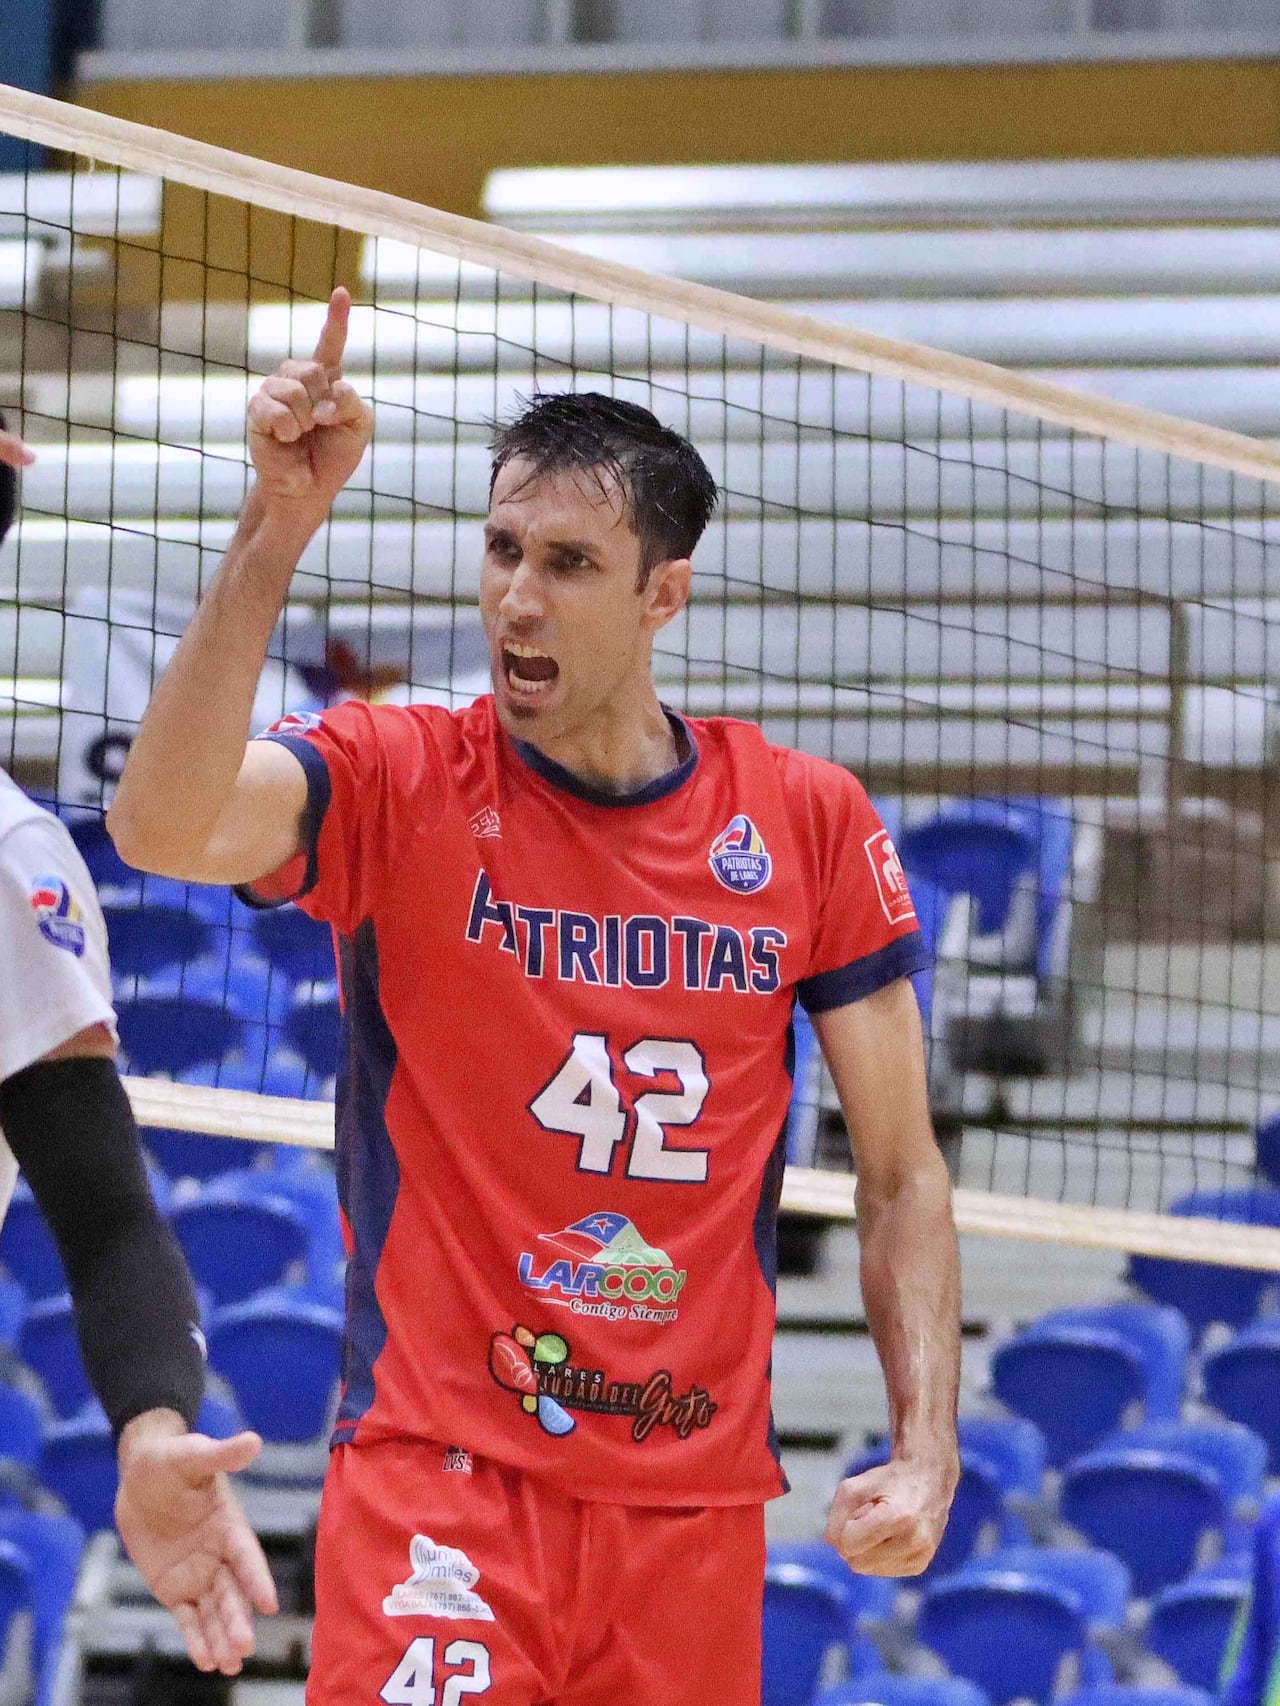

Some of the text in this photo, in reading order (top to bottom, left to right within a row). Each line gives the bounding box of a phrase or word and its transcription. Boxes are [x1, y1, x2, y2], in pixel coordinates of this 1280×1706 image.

[721, 857, 762, 871] PATRIOTAS
[730, 871, 740, 881] DE
[529, 1030, 713, 1184] 42
[570, 1298, 678, 1325] Contigo Siempre
[533, 1362, 602, 1384] LARES
[378, 1635, 493, 1706] 42
